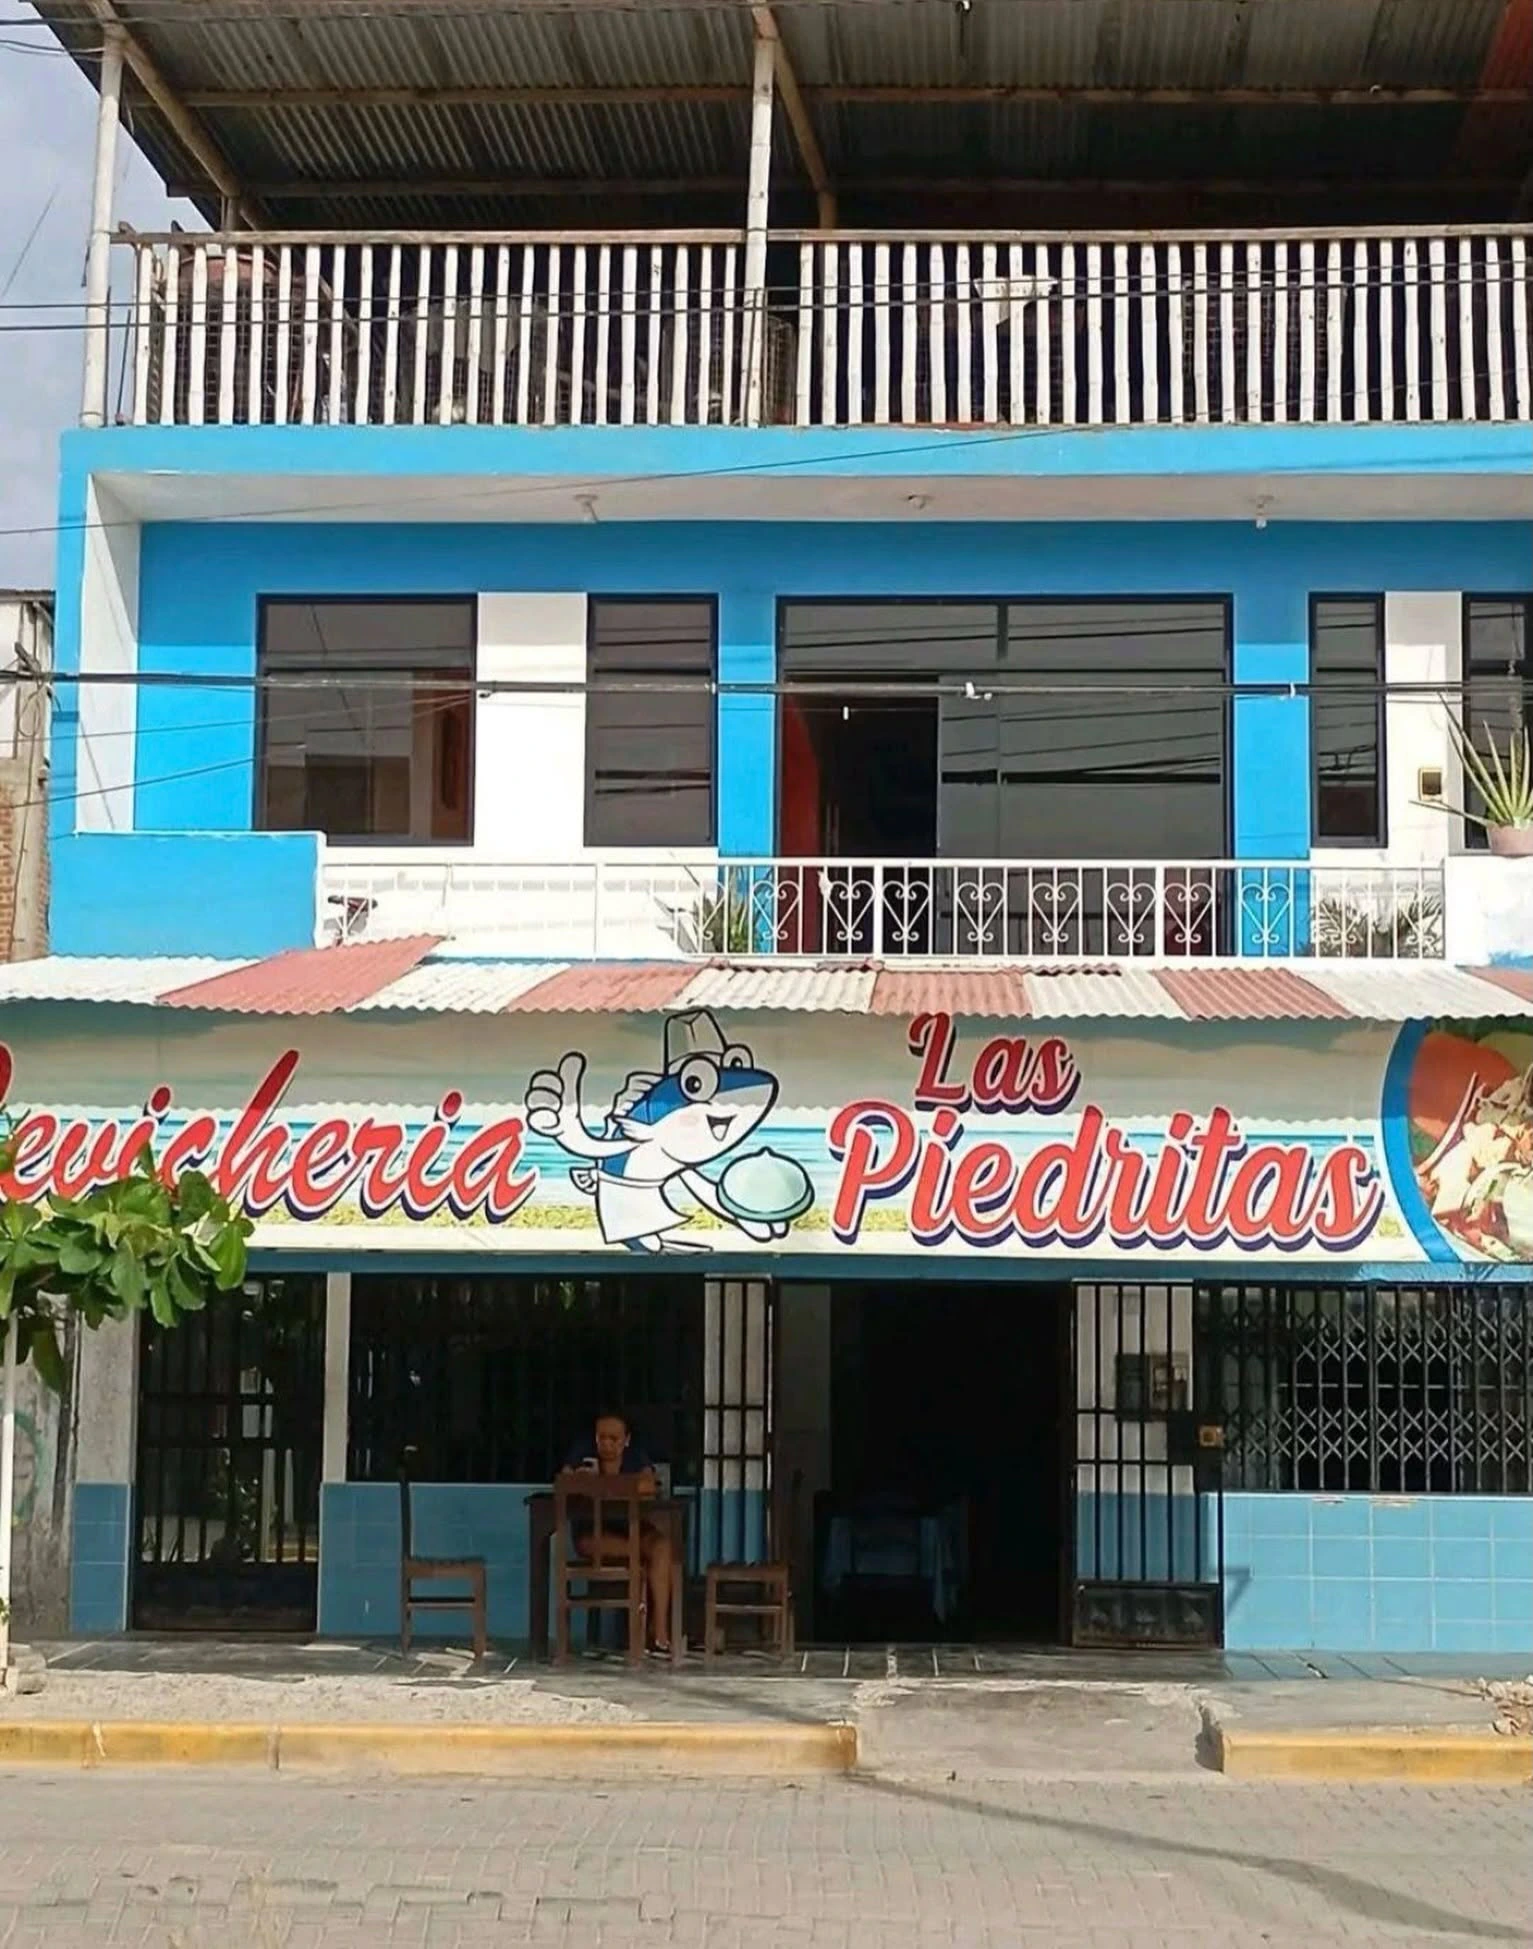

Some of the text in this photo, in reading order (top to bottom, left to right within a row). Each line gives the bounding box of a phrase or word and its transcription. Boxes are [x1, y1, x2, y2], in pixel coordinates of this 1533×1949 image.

[0, 1042, 537, 1224] evicheria
[907, 1012, 1081, 1114] Las
[827, 1100, 1386, 1251] Piedritas
